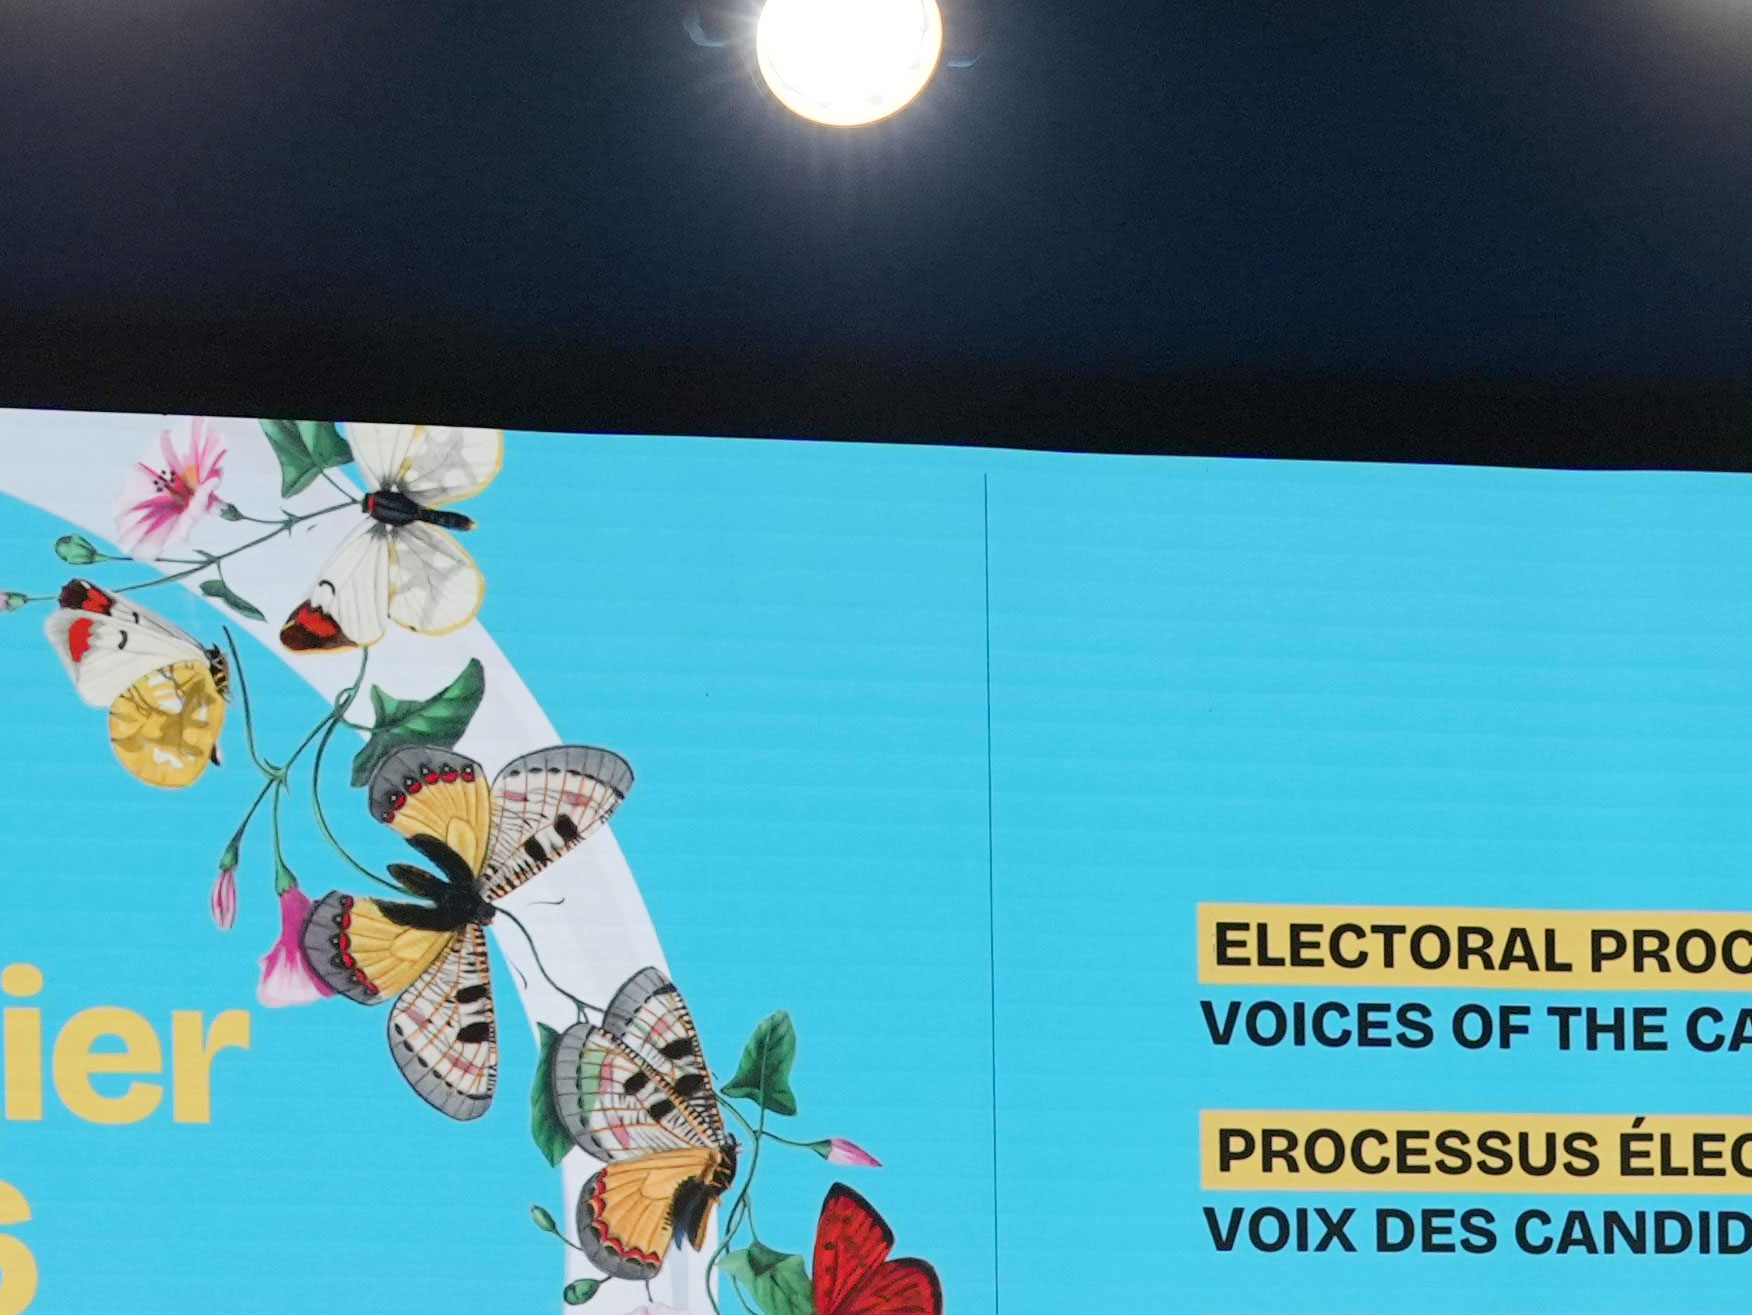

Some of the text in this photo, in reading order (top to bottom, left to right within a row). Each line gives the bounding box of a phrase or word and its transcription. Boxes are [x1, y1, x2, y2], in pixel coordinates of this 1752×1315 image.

[1213, 921, 1574, 974] ELECTORAL
[1200, 1000, 1434, 1049] VOICES
[1451, 1005, 1530, 1050] OF
[1557, 1005, 1669, 1052] THE
[1217, 1127, 1600, 1178] PROCESSUS
[1202, 1206, 1358, 1253] VOIX
[1376, 1208, 1498, 1255] DES
